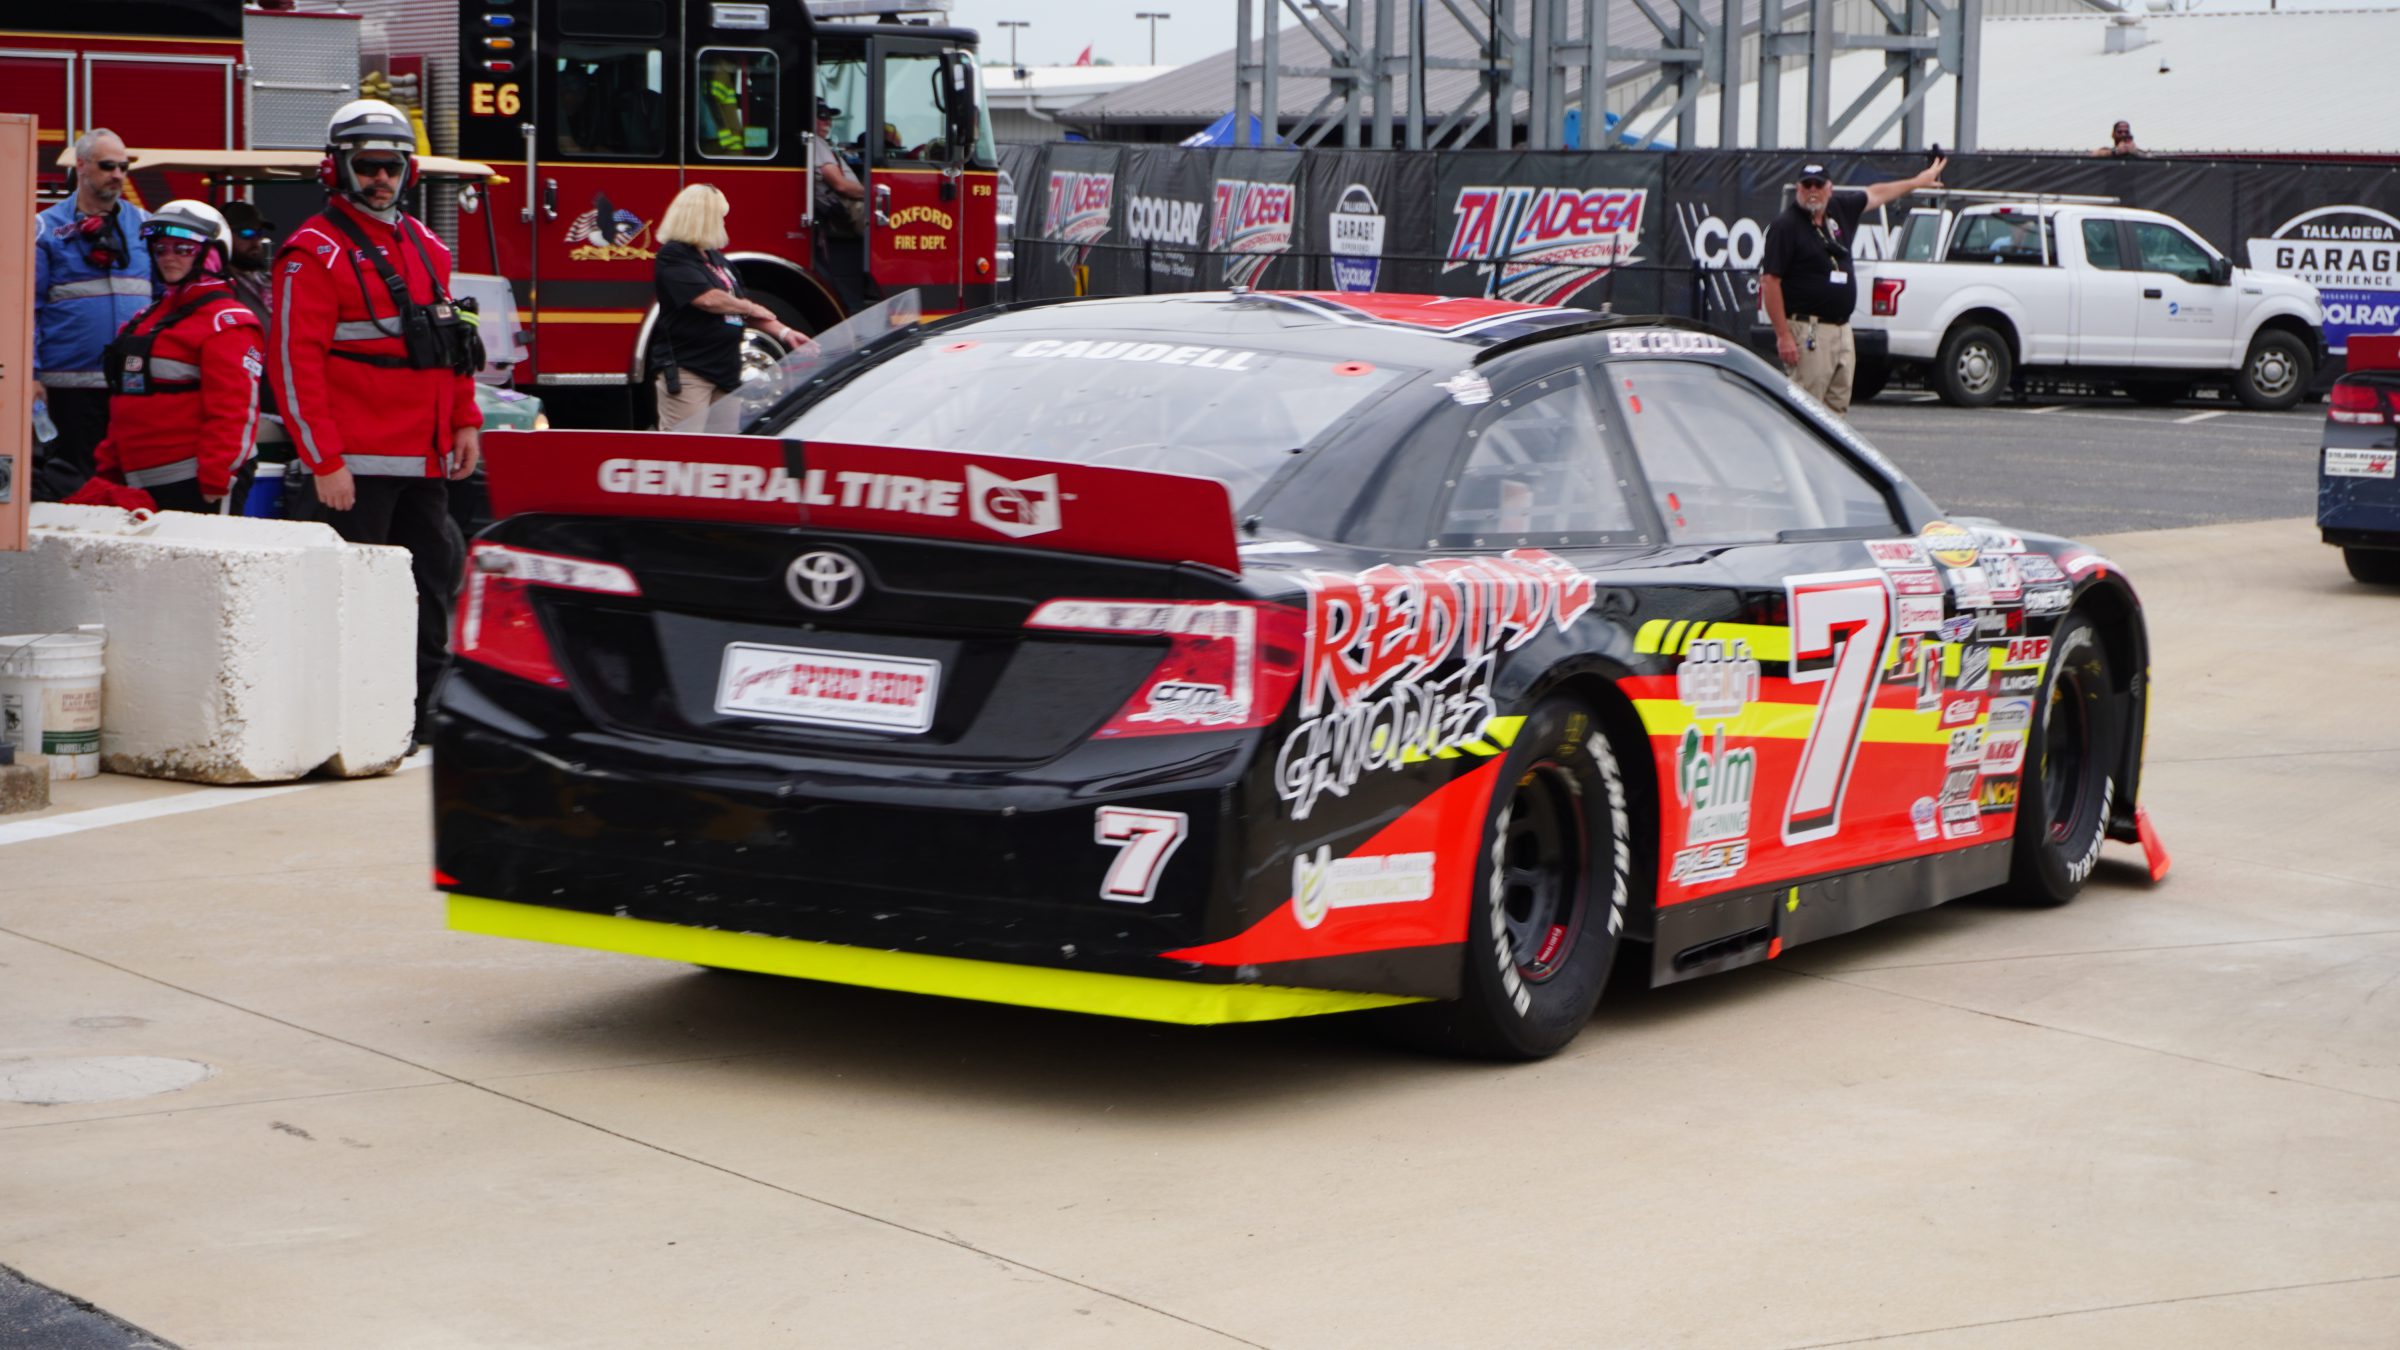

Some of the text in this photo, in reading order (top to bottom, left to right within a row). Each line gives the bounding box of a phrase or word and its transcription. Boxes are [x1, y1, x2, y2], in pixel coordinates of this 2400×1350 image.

[471, 82, 520, 115] E6
[973, 184, 992, 196] F30
[890, 206, 952, 230] OXFORD
[1128, 196, 1203, 245] COOLRAY
[1337, 219, 1375, 241] GARAGE
[1442, 187, 1648, 274] TALLADEGA
[895, 235, 947, 249] FIRE DEPT.
[2301, 225, 2394, 240] TALLADEGA
[2276, 248, 2400, 272] GARAG
[1010, 340, 1257, 371] CAUDELL
[598, 458, 964, 517] GENERAL TIRE
[2007, 638, 2049, 662] ARP
[1782, 568, 1897, 846] 7
[1095, 805, 1188, 903] 7
